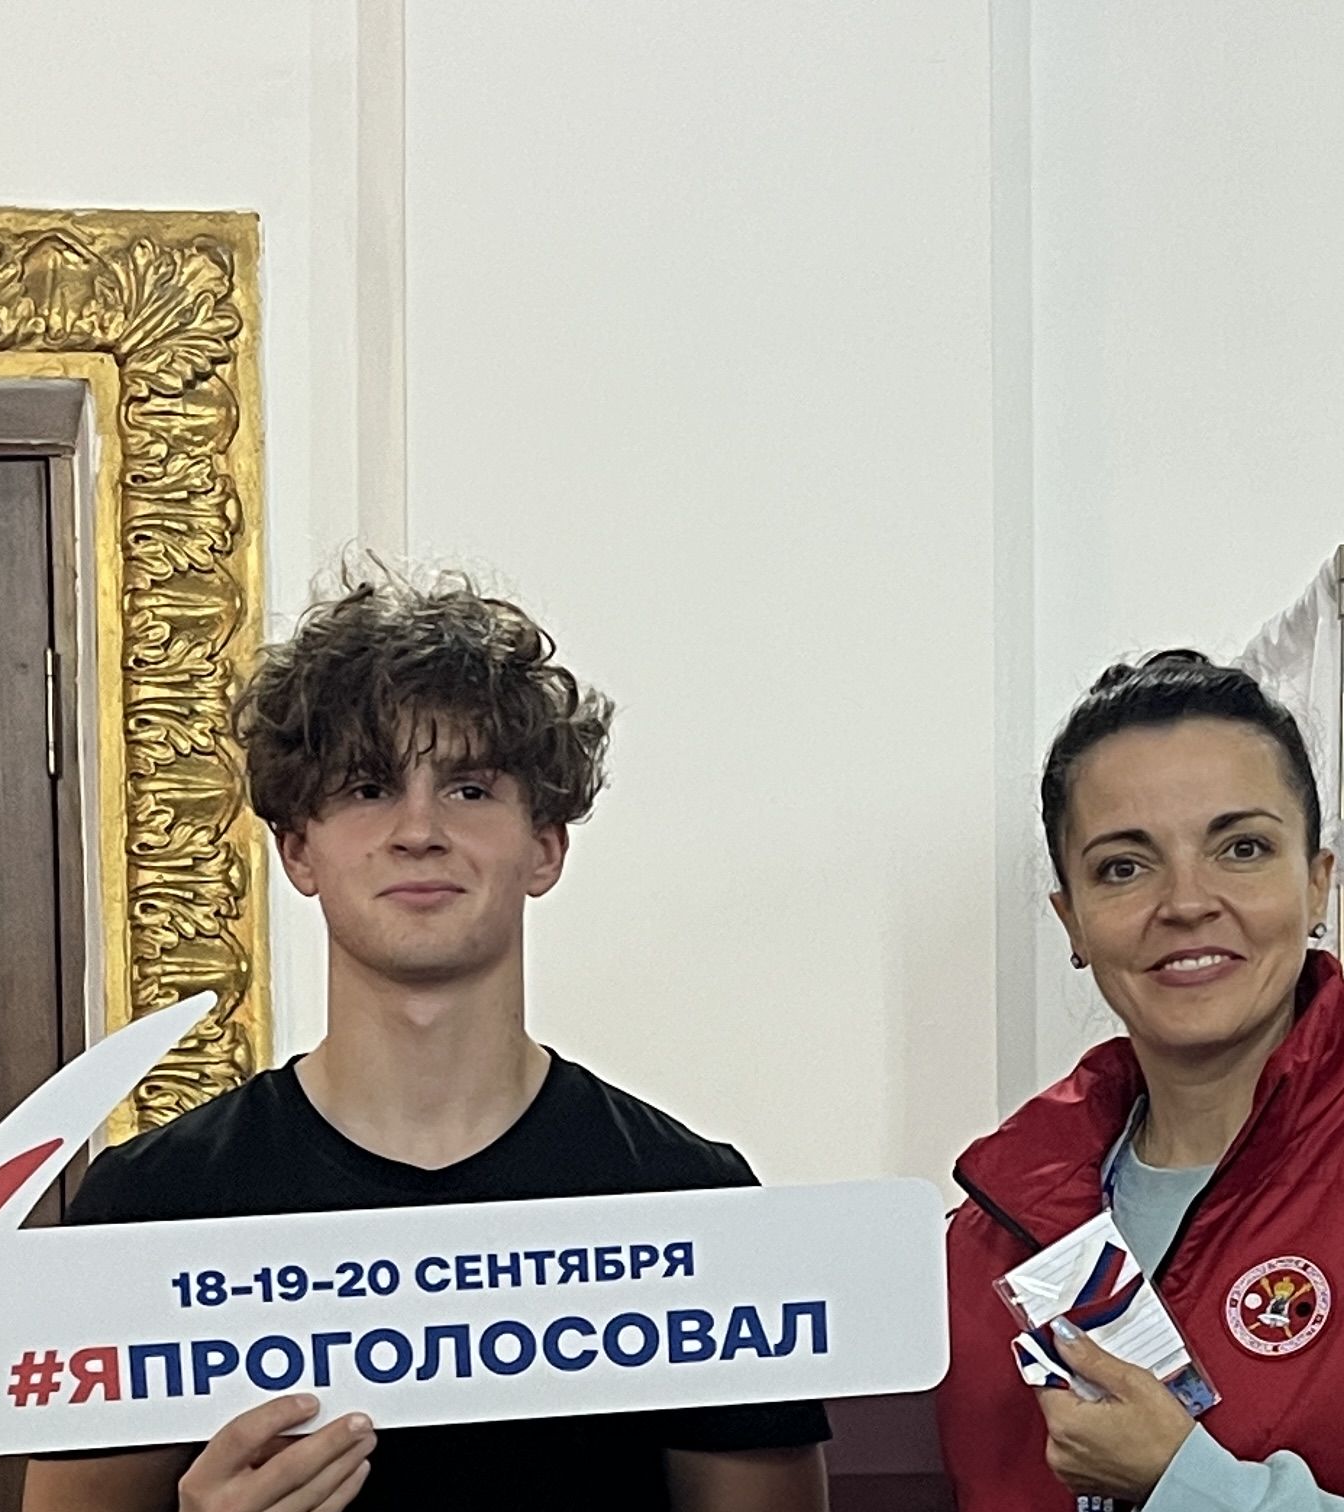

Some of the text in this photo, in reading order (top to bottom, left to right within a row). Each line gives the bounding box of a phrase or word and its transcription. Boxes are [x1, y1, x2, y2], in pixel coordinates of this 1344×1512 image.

[171, 1241, 695, 1308] 18-19-20 СЕНТЯБРЯ
[7, 1300, 829, 1407] #ЯПРОГОЛОСОВАЛ
